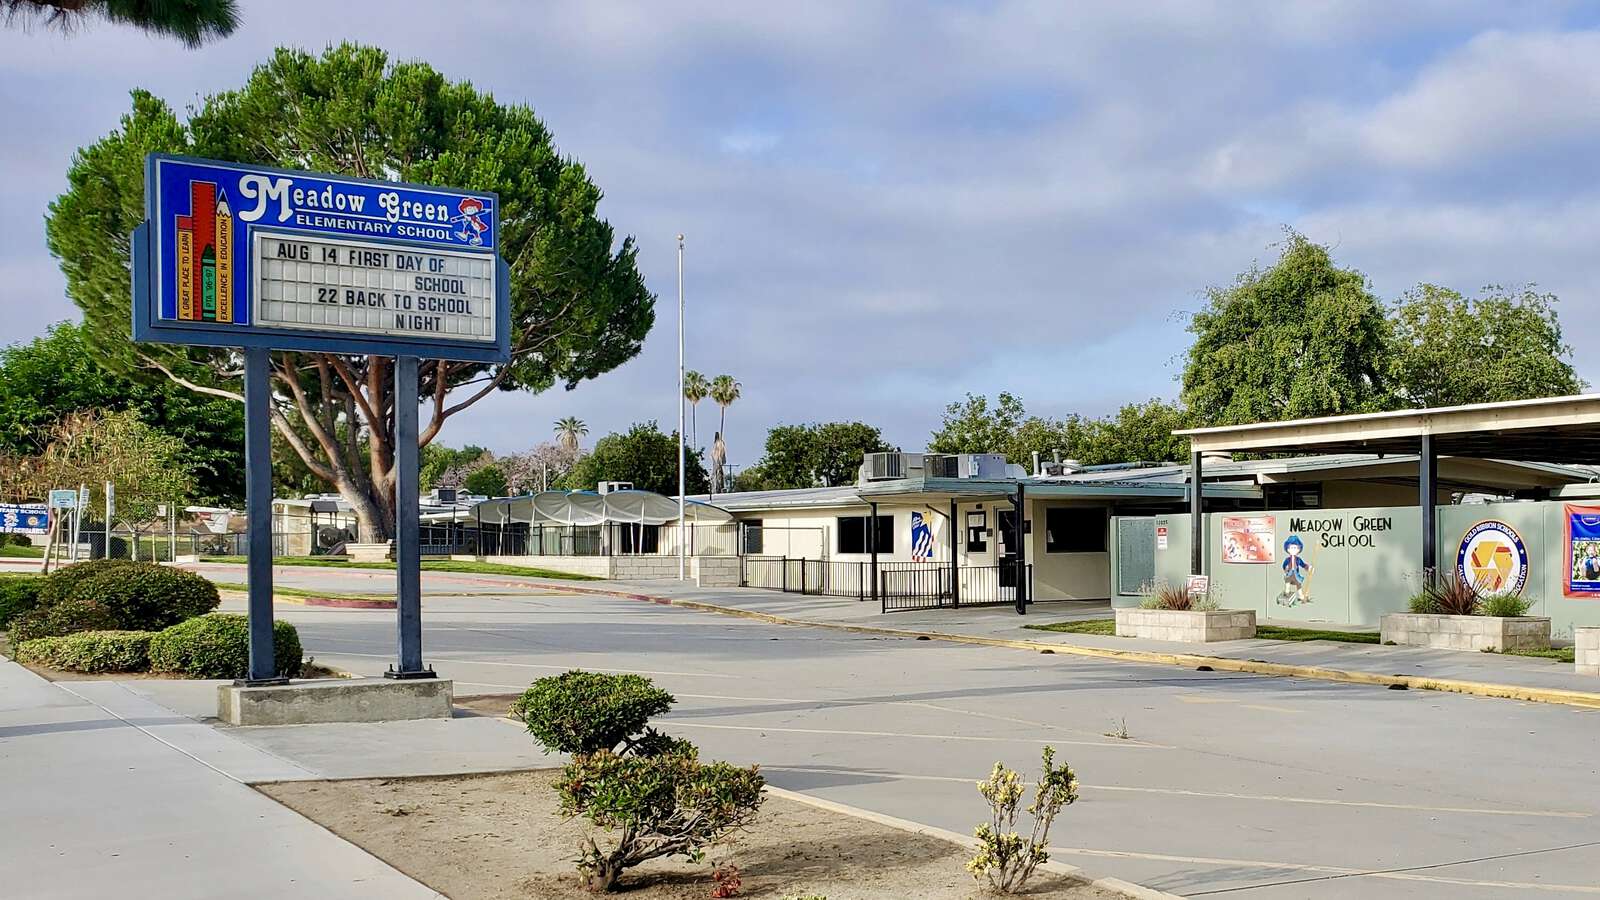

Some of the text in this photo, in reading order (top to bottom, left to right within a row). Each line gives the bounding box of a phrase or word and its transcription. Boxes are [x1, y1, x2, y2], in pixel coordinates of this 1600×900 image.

[239, 174, 449, 223] Meadow Green
[296, 214, 453, 240] ELEMENTARY SCHOOL
[182, 233, 190, 254] LEARN
[182, 256, 190, 265] TO
[277, 243, 445, 273] AUG 14 FIRST DAY OF
[182, 267, 190, 287] PLACE
[220, 219, 228, 320] EXCELLENCE IN EDUCATION
[415, 276, 466, 295] SCHOOL
[182, 290, 190, 310] GREAT
[318, 288, 472, 315] 22 BACK TO SCHOOL
[396, 314, 441, 331] NIGHT
[1290, 518, 1343, 532] MEADOW
[1353, 516, 1392, 531] GREEN
[1464, 528, 1478, 543] GOLD
[1497, 523, 1519, 543] SCHOOLS
[1321, 533, 1376, 548] SCHOOL
